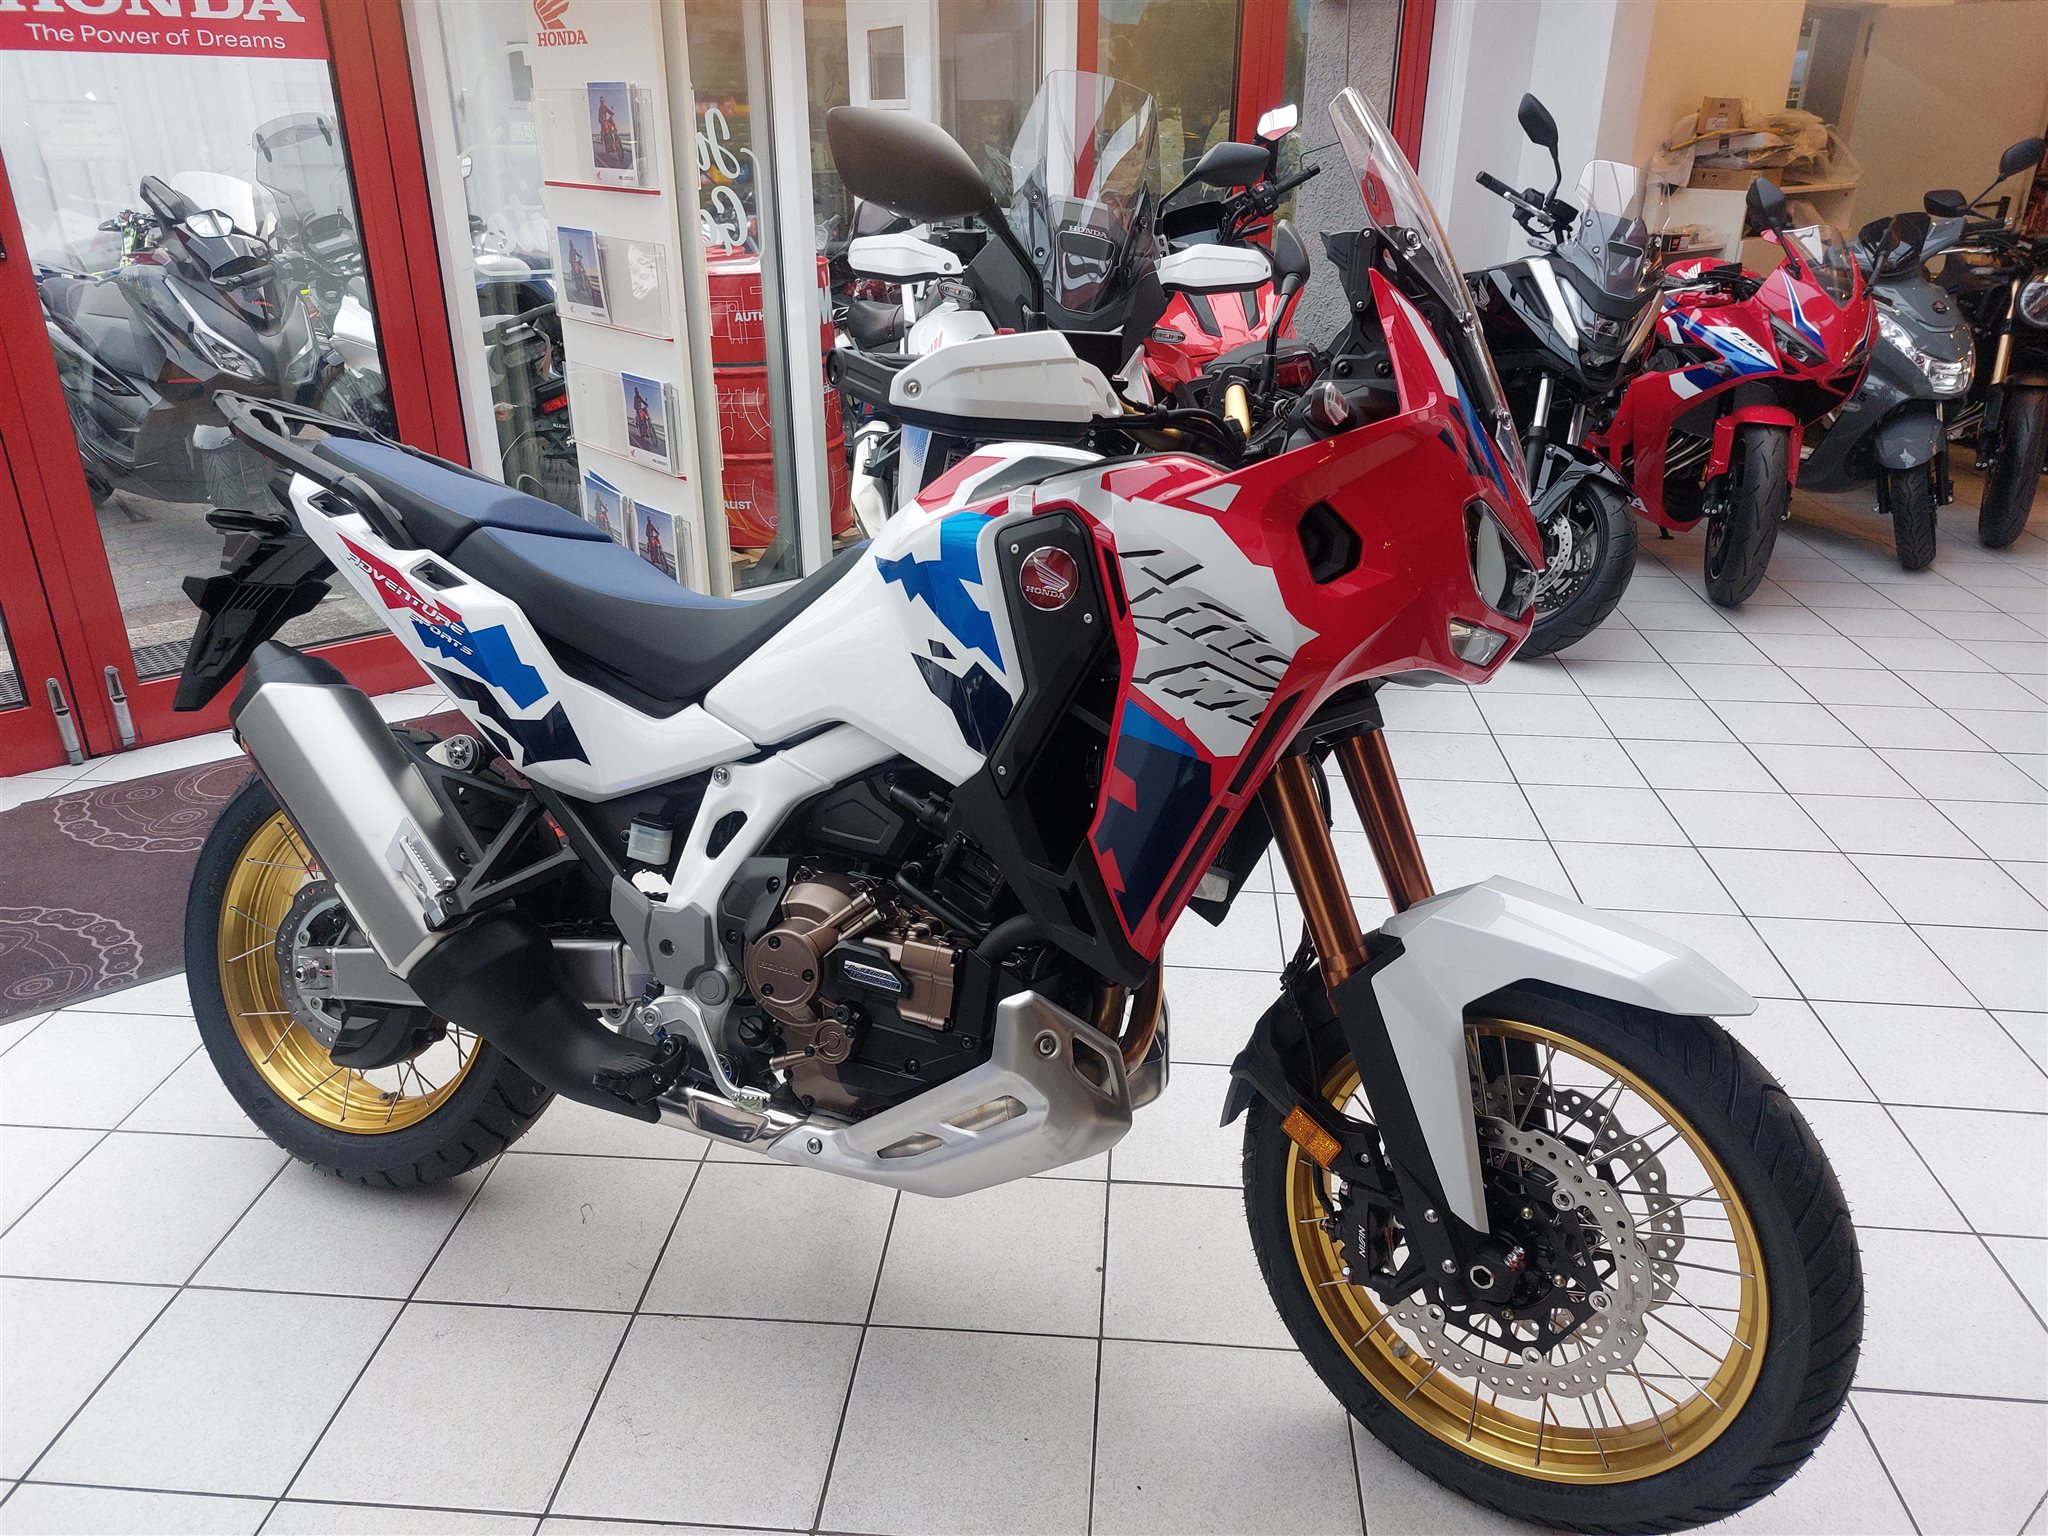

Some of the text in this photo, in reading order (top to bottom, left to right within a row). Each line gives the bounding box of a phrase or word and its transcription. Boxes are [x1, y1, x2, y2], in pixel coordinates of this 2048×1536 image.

[24, 23, 286, 49] The Power of Dreams
[537, 30, 588, 47] HONDA
[1068, 225, 1108, 239] HONDA
[347, 553, 466, 636] ADVENTURE
[1025, 585, 1067, 600] HONDA
[409, 612, 474, 656] SPORTS
